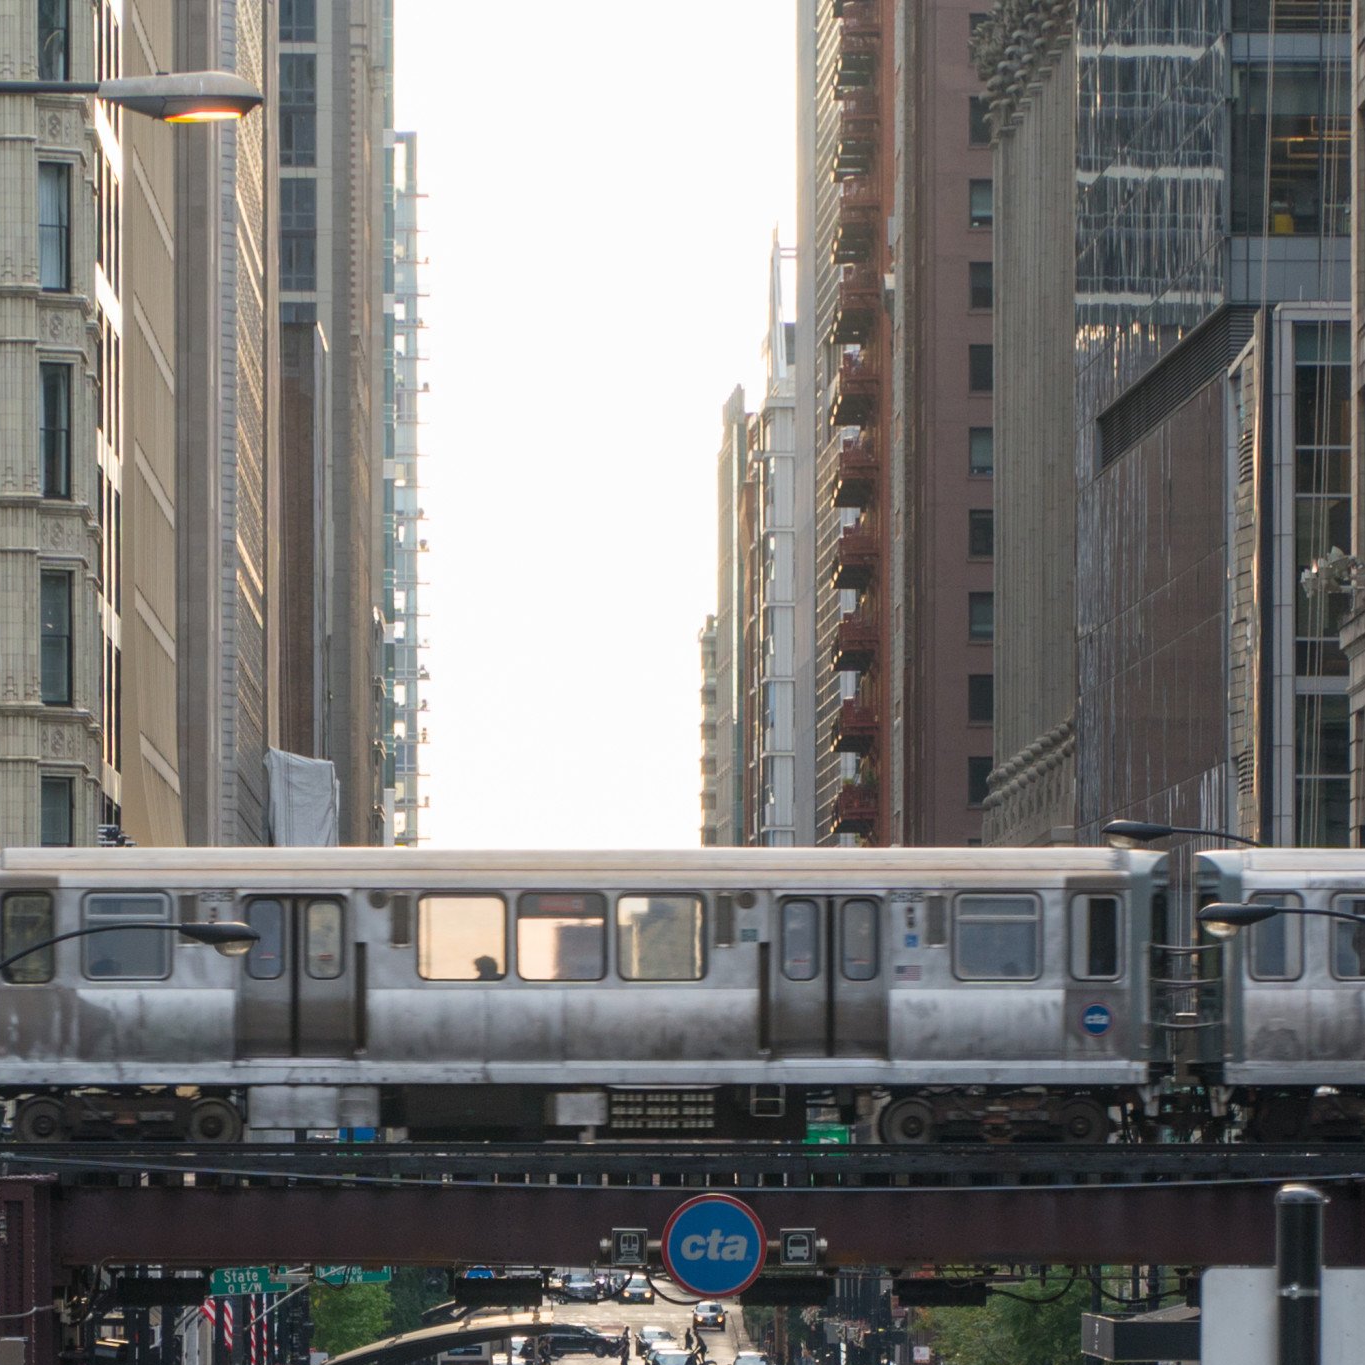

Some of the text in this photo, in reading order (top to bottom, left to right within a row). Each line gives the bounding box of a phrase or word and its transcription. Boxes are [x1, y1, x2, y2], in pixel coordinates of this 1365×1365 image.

[681, 1229, 748, 1260] cta
[224, 1270, 259, 1283] State
[241, 1283, 262, 1293] E/W
